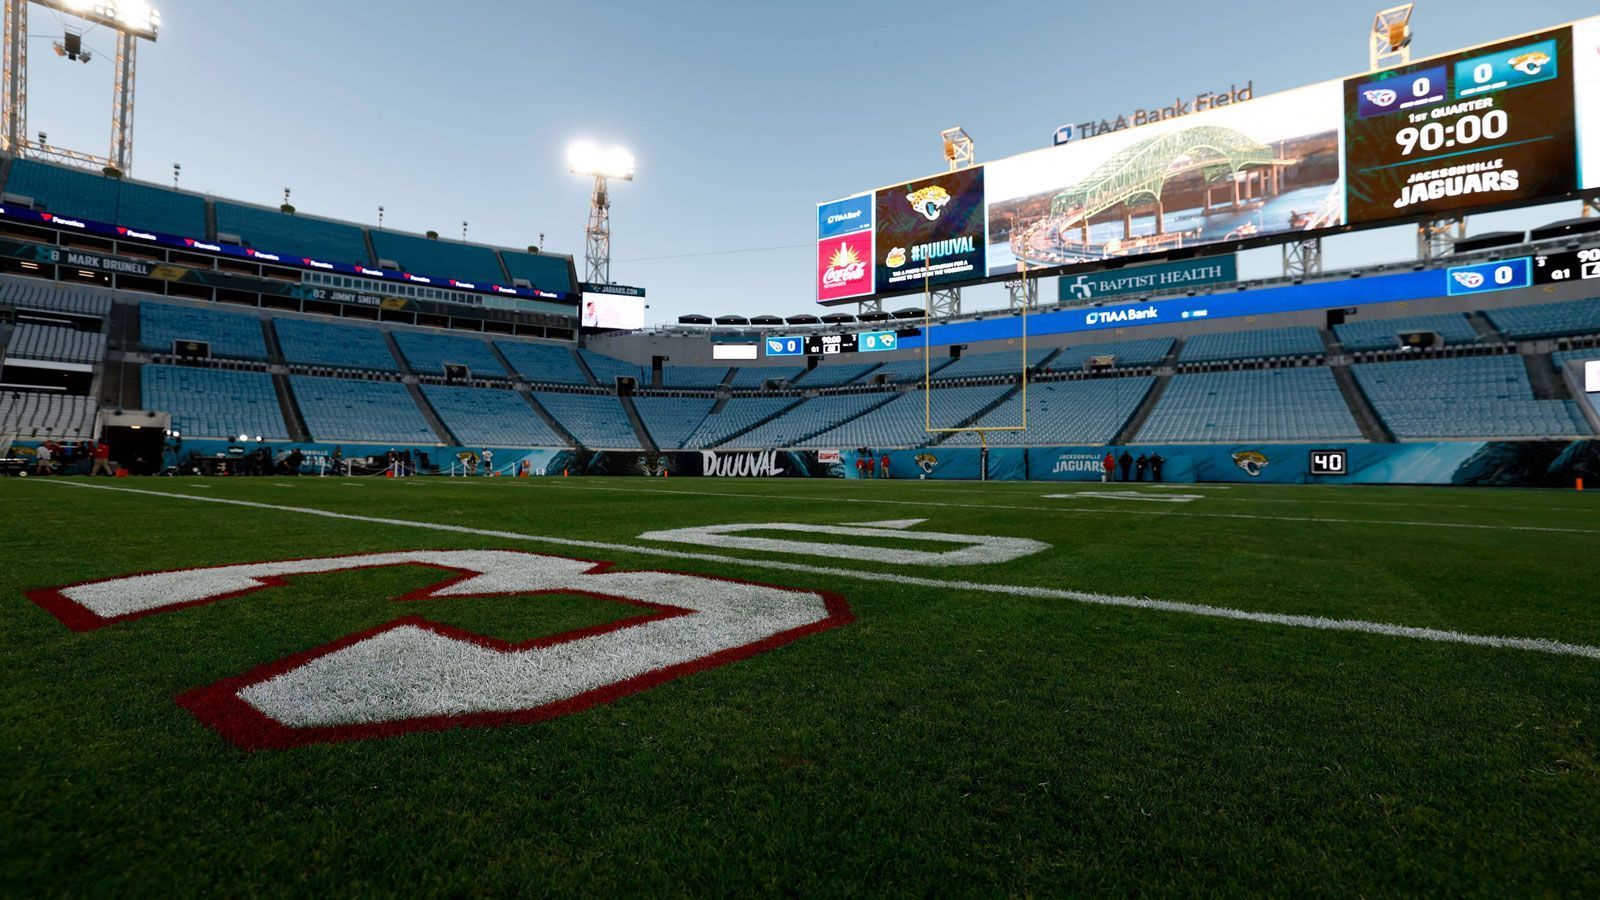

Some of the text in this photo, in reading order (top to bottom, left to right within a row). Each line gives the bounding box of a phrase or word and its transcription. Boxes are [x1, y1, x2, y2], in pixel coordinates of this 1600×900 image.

[1474, 63, 1493, 83] 0
[1412, 77, 1431, 97] 0
[1077, 80, 1254, 139] TIAA Bank Field
[1430, 97, 1493, 119] QUARTER
[1395, 109, 1508, 156] 90:00
[1407, 158, 1504, 183] JACKSONVILLE
[1393, 169, 1519, 209] JAGUARS
[52, 216, 85, 228] Fanatics
[126, 229, 157, 241] Fanatics
[910, 235, 976, 262] #DUUUVAL
[51, 250, 61, 261] 8
[68, 253, 100, 268] MARK
[103, 259, 149, 275] BRUNELL
[823, 261, 867, 285] Coca-Cola
[1099, 265, 1222, 292] BAPTIST HEALTH
[1494, 265, 1513, 284] 0
[1551, 268, 1570, 280] Q1
[312, 289, 326, 299] 82
[330, 292, 355, 304] JIMMY
[357, 294, 380, 305] SMITH
[602, 285, 638, 296] JAGUARS.COM
[1099, 306, 1158, 323] TIAA Bank
[787, 341, 796, 352] 0
[866, 336, 876, 348] 0
[701, 450, 784, 477] DUUUVAL
[819, 452, 839, 461] ESPN
[1314, 454, 1343, 471] 40
[1052, 460, 1106, 473] JAGUARS
